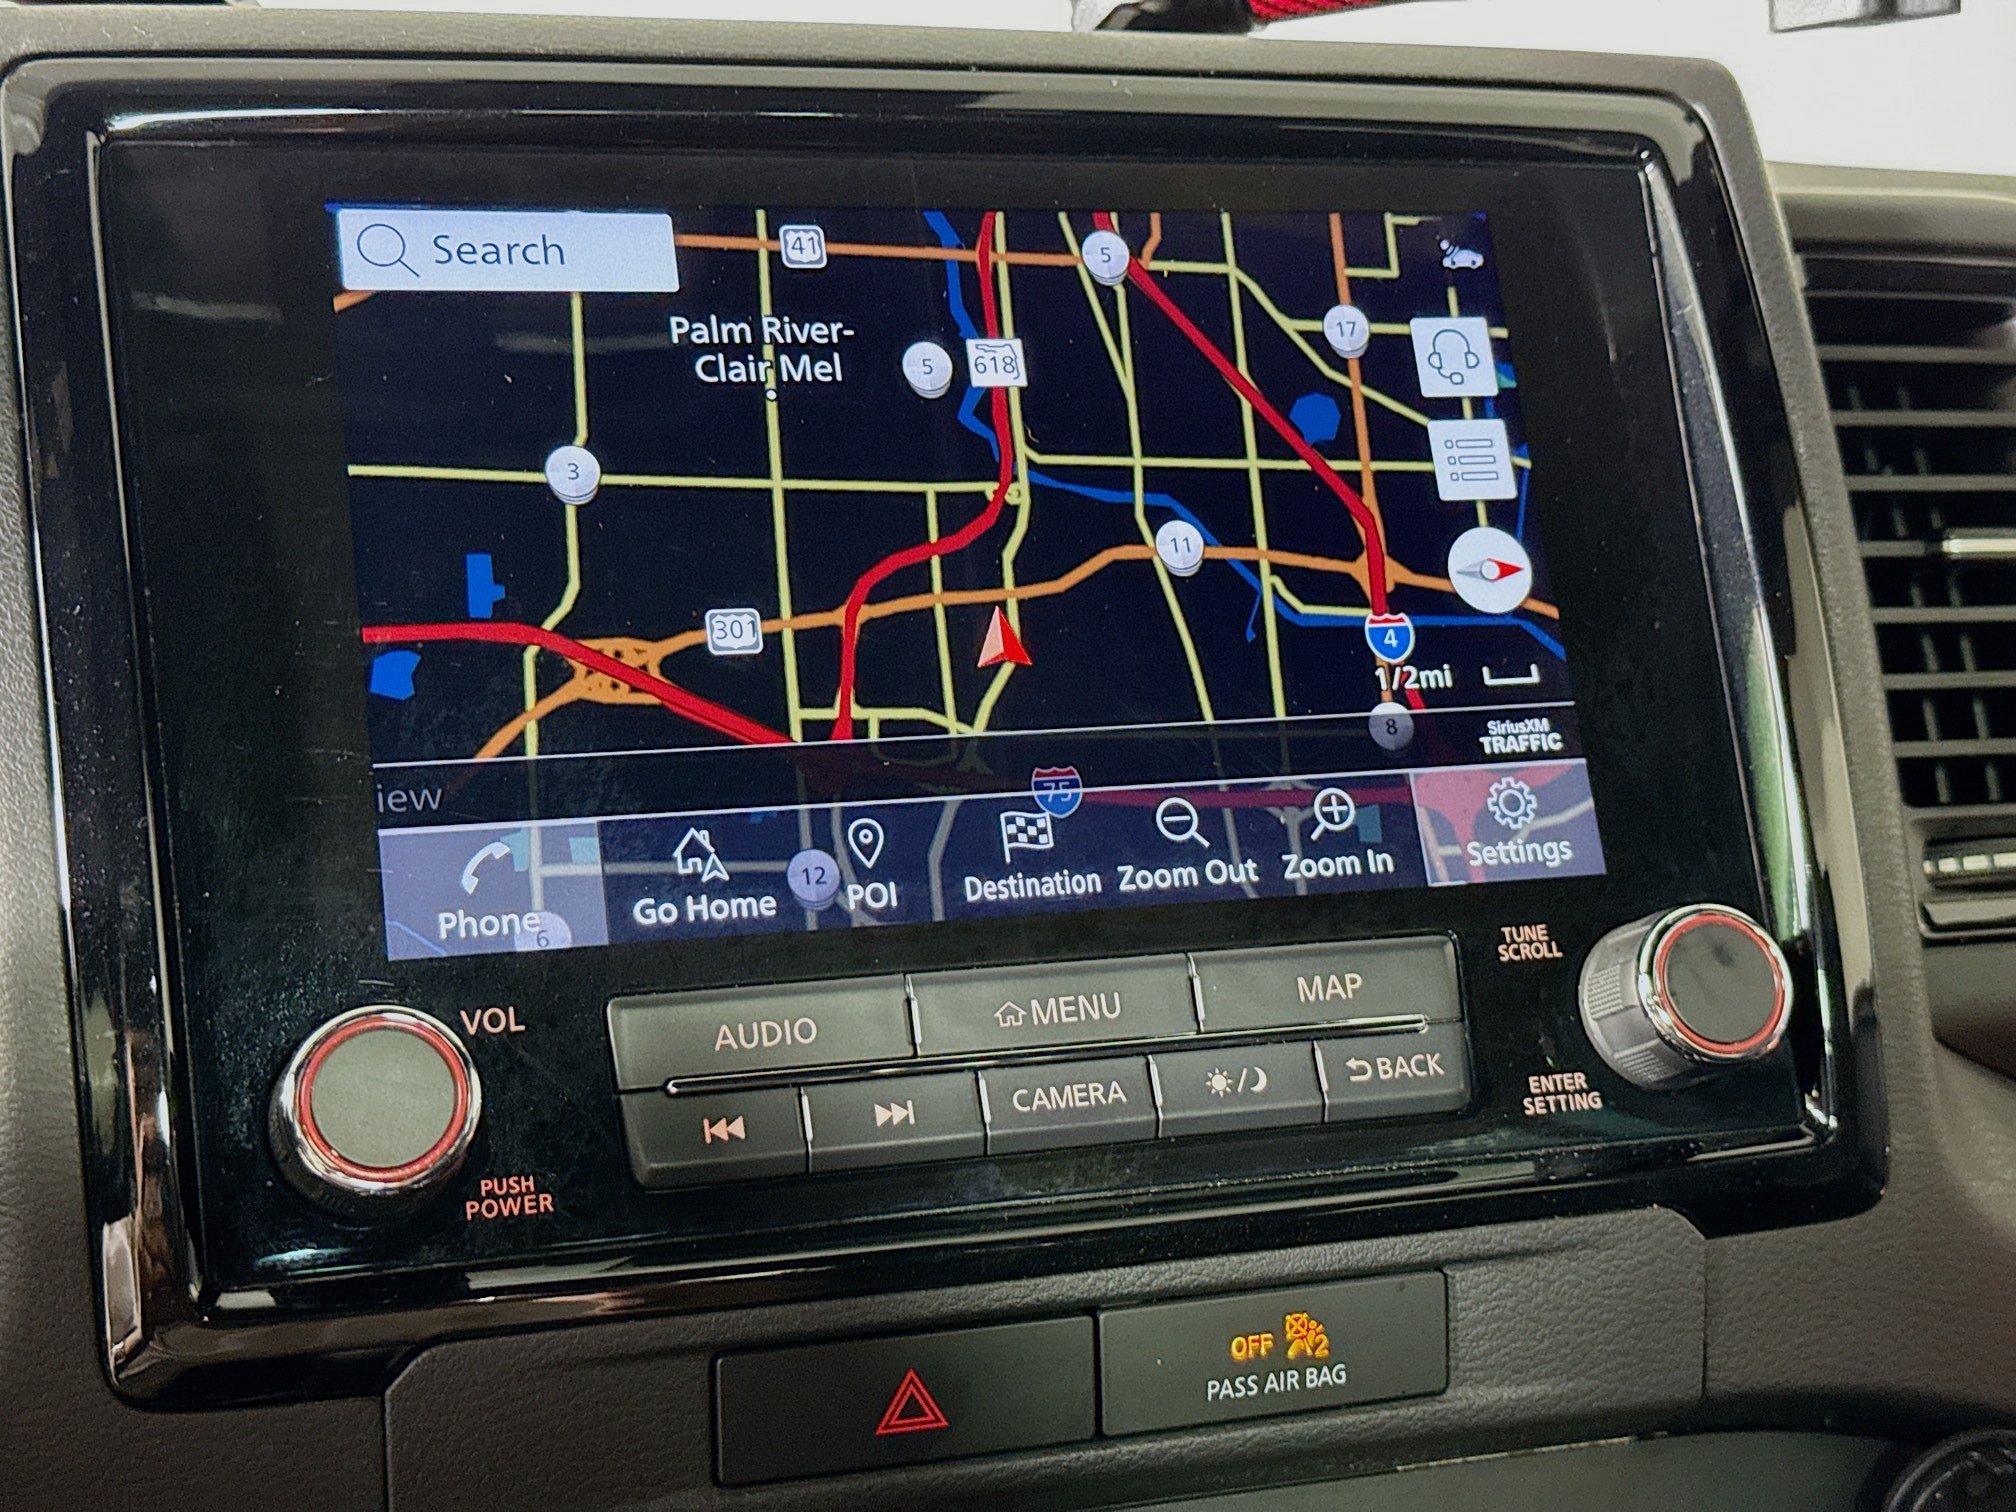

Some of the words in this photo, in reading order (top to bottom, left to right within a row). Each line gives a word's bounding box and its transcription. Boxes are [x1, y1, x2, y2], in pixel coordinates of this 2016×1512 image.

[433, 234, 566, 267] Search
[791, 236, 818, 256] 41
[1099, 247, 1112, 264] 5
[669, 315, 751, 345] Palm
[763, 316, 855, 345] River-
[1335, 320, 1357, 338] 17
[695, 353, 770, 383] Clair
[780, 353, 843, 383] Mel
[922, 358, 934, 376] 5
[973, 353, 1018, 377] 618
[566, 463, 580, 481] 3
[1170, 536, 1191, 554] 11
[715, 620, 757, 640] 301
[1383, 629, 1398, 648] 4
[1375, 664, 1453, 691] 1/2mi
[1385, 718, 1398, 736] 8
[1486, 717, 1550, 735] SiriusXM
[1479, 732, 1564, 755] TRAFFIC
[1043, 780, 1072, 803] 75
[1281, 852, 1363, 880] Zoom
[1367, 848, 1395, 874] In
[1466, 839, 1573, 868] Settings
[803, 865, 825, 885] 12
[964, 867, 1102, 902] Destination
[1117, 863, 1199, 892] Zoom
[1205, 857, 1260, 885] Out
[848, 881, 897, 910] POI
[632, 898, 678, 926] Go
[687, 893, 777, 922] Home
[438, 909, 541, 940] Phone
[1500, 923, 1550, 943] TUNE
[536, 929, 549, 948] 6
[1497, 940, 1564, 962] SCROLL
[1296, 972, 1363, 1003] MAP
[459, 1005, 526, 1036] VOL
[1030, 991, 1122, 1025] MENU
[714, 1017, 818, 1052] AUDIO
[1375, 1052, 1445, 1081] BACK
[1012, 1080, 1128, 1113] CAMERA
[1528, 1072, 1589, 1095] ENTER
[1522, 1091, 1603, 1116] SETTING
[480, 1175, 535, 1197] PUSH
[465, 1193, 554, 1221] POWER
[1231, 1332, 1274, 1361] OFF
[1207, 1374, 1259, 1402] PASS
[1263, 1369, 1300, 1394] AIR
[1305, 1363, 1347, 1389] BAG
